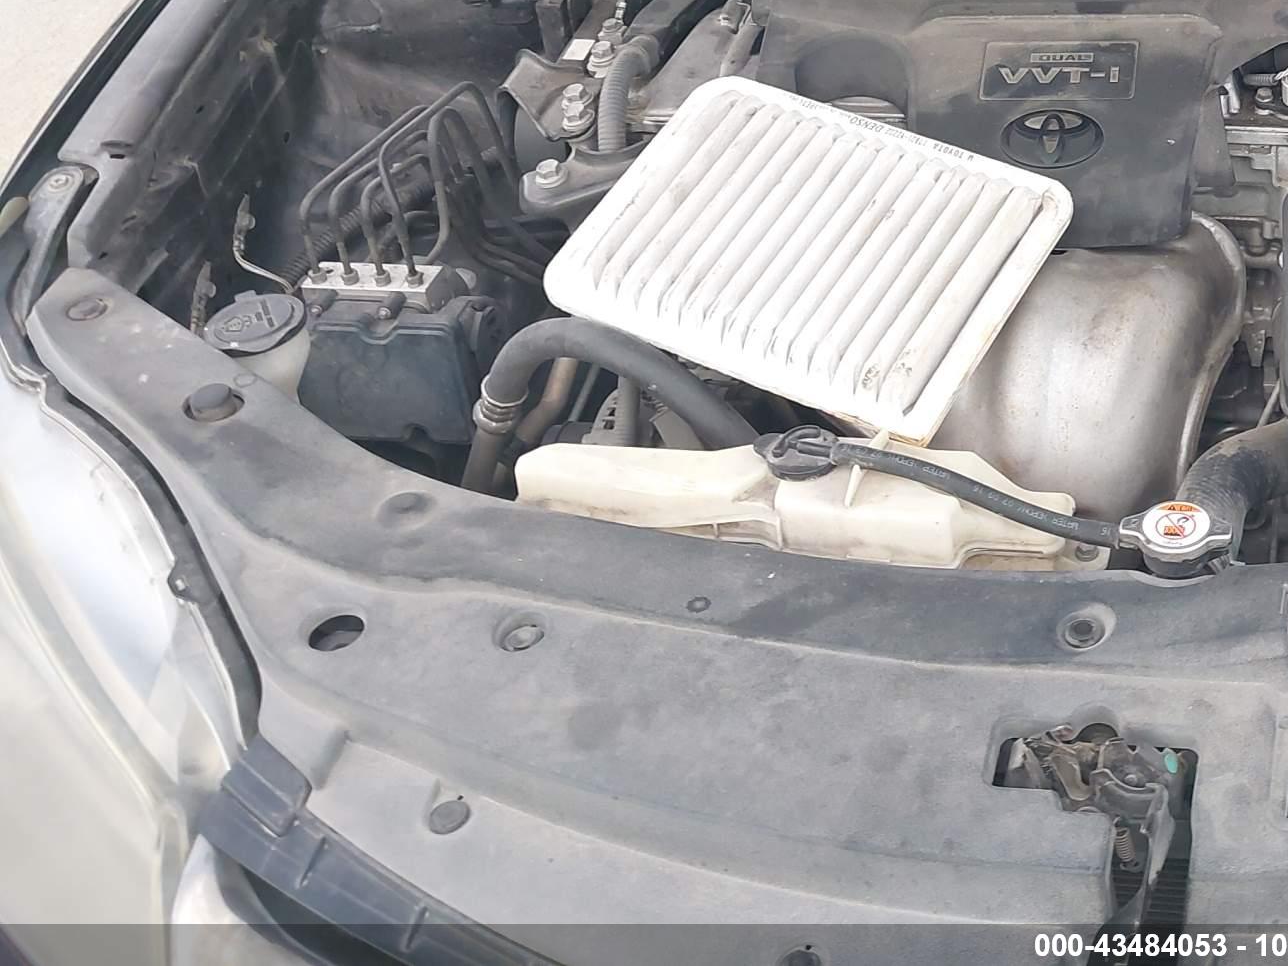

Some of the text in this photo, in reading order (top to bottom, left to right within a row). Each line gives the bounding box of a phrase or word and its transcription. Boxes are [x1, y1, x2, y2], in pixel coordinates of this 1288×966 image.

[1036, 54, 1087, 62] DUAL
[849, 114, 885, 134] DENSO
[932, 142, 965, 160] TOYOTA
